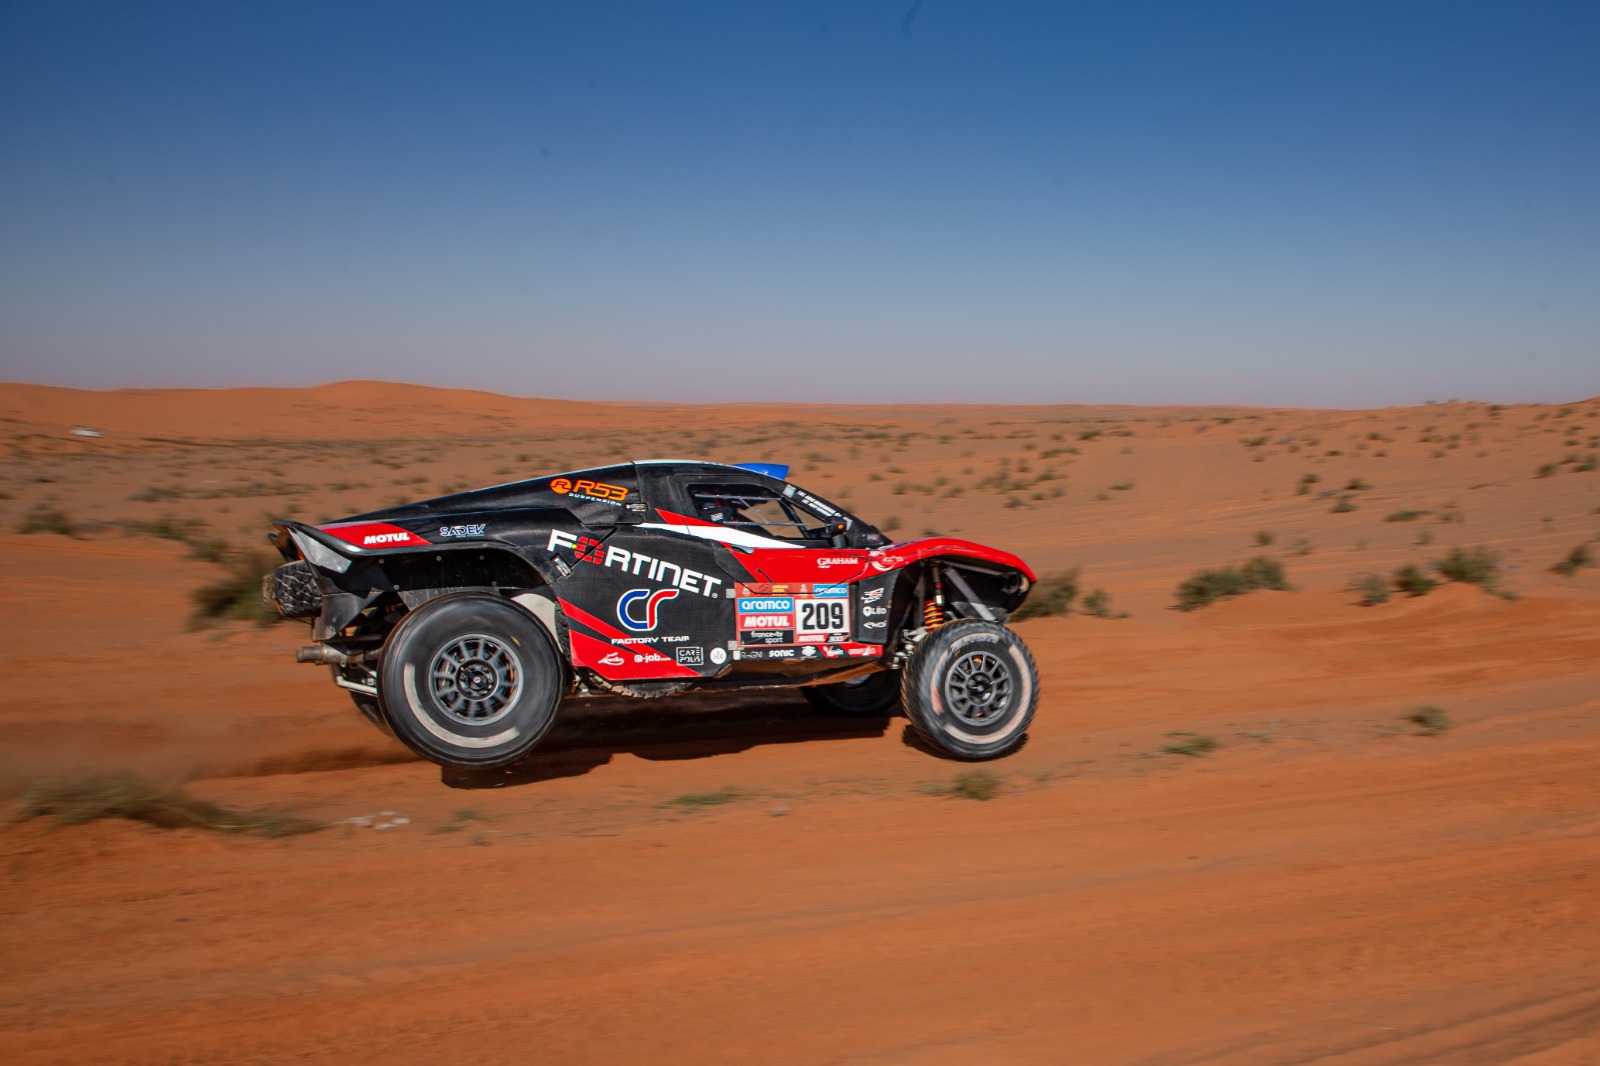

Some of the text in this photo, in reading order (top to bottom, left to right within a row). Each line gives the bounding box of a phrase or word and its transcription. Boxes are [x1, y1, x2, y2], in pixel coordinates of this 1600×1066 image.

[573, 480, 629, 501] R53
[568, 492, 622, 507] SUSPENSION
[440, 524, 486, 536] SADEV
[363, 532, 410, 545] MOTUL
[816, 557, 858, 566] GRAHAM
[741, 600, 790, 610] aramco
[743, 616, 790, 627] MOTUL
[801, 602, 844, 630] 209
[611, 637, 659, 645] FACTORY
[768, 649, 795, 658] SONIC
